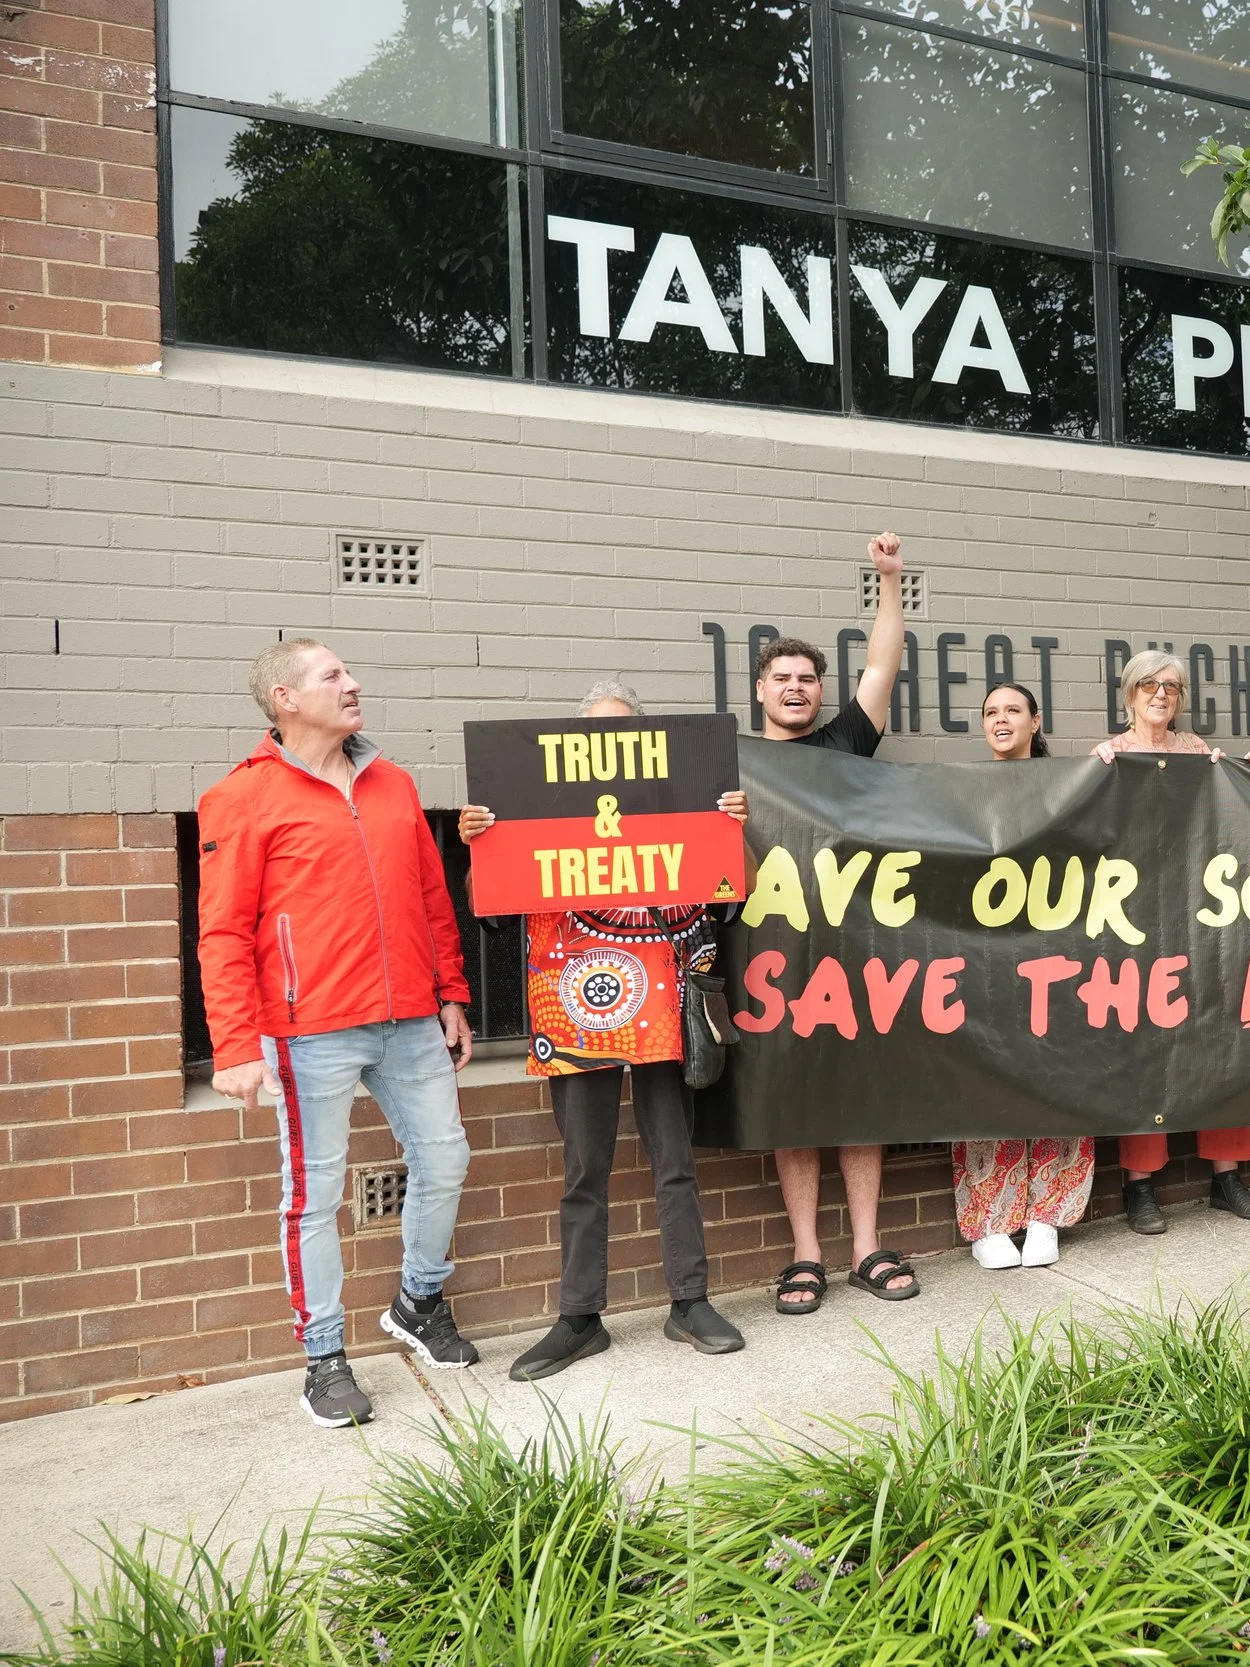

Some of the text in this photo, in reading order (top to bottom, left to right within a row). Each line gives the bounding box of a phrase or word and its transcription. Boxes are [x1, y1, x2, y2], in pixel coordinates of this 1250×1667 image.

[547, 215, 1031, 394] TANYA
[538, 730, 668, 783] TRUTH
[594, 794, 622, 838] &
[534, 843, 684, 898] TREATY
[741, 846, 921, 931] AVE
[972, 854, 1146, 945] OUR
[733, 950, 966, 1040] SAVE
[1017, 955, 1189, 1037] THE
[281, 1065, 293, 1096] GUESS
